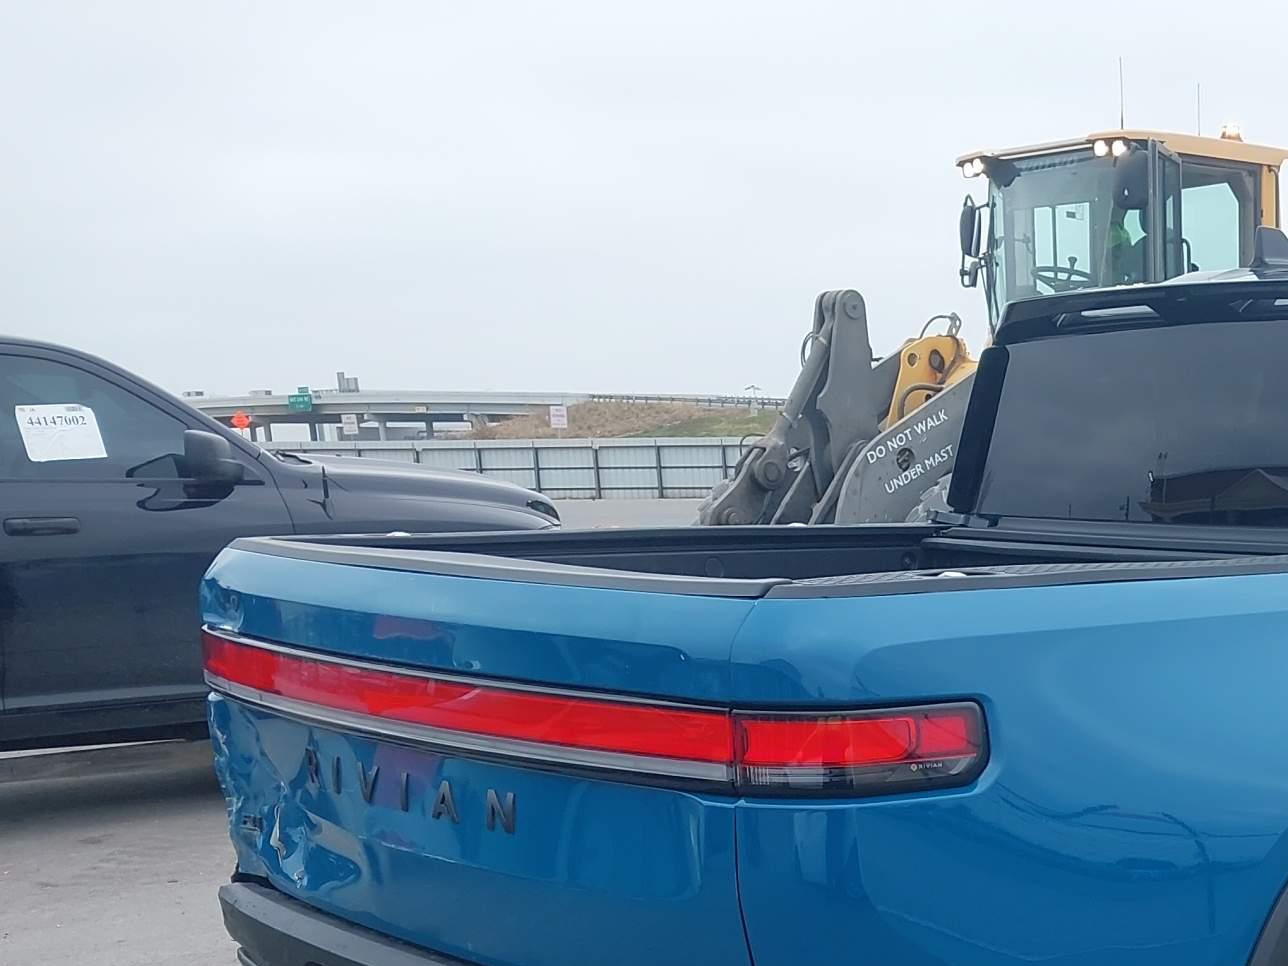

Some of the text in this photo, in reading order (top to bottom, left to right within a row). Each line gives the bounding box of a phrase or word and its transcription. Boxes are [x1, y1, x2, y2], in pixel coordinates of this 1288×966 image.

[26, 415, 87, 426] 44147002
[866, 408, 948, 464] DO NOT WALK
[884, 444, 954, 493] UNDER MAST
[304, 747, 517, 834] RIVIAN
